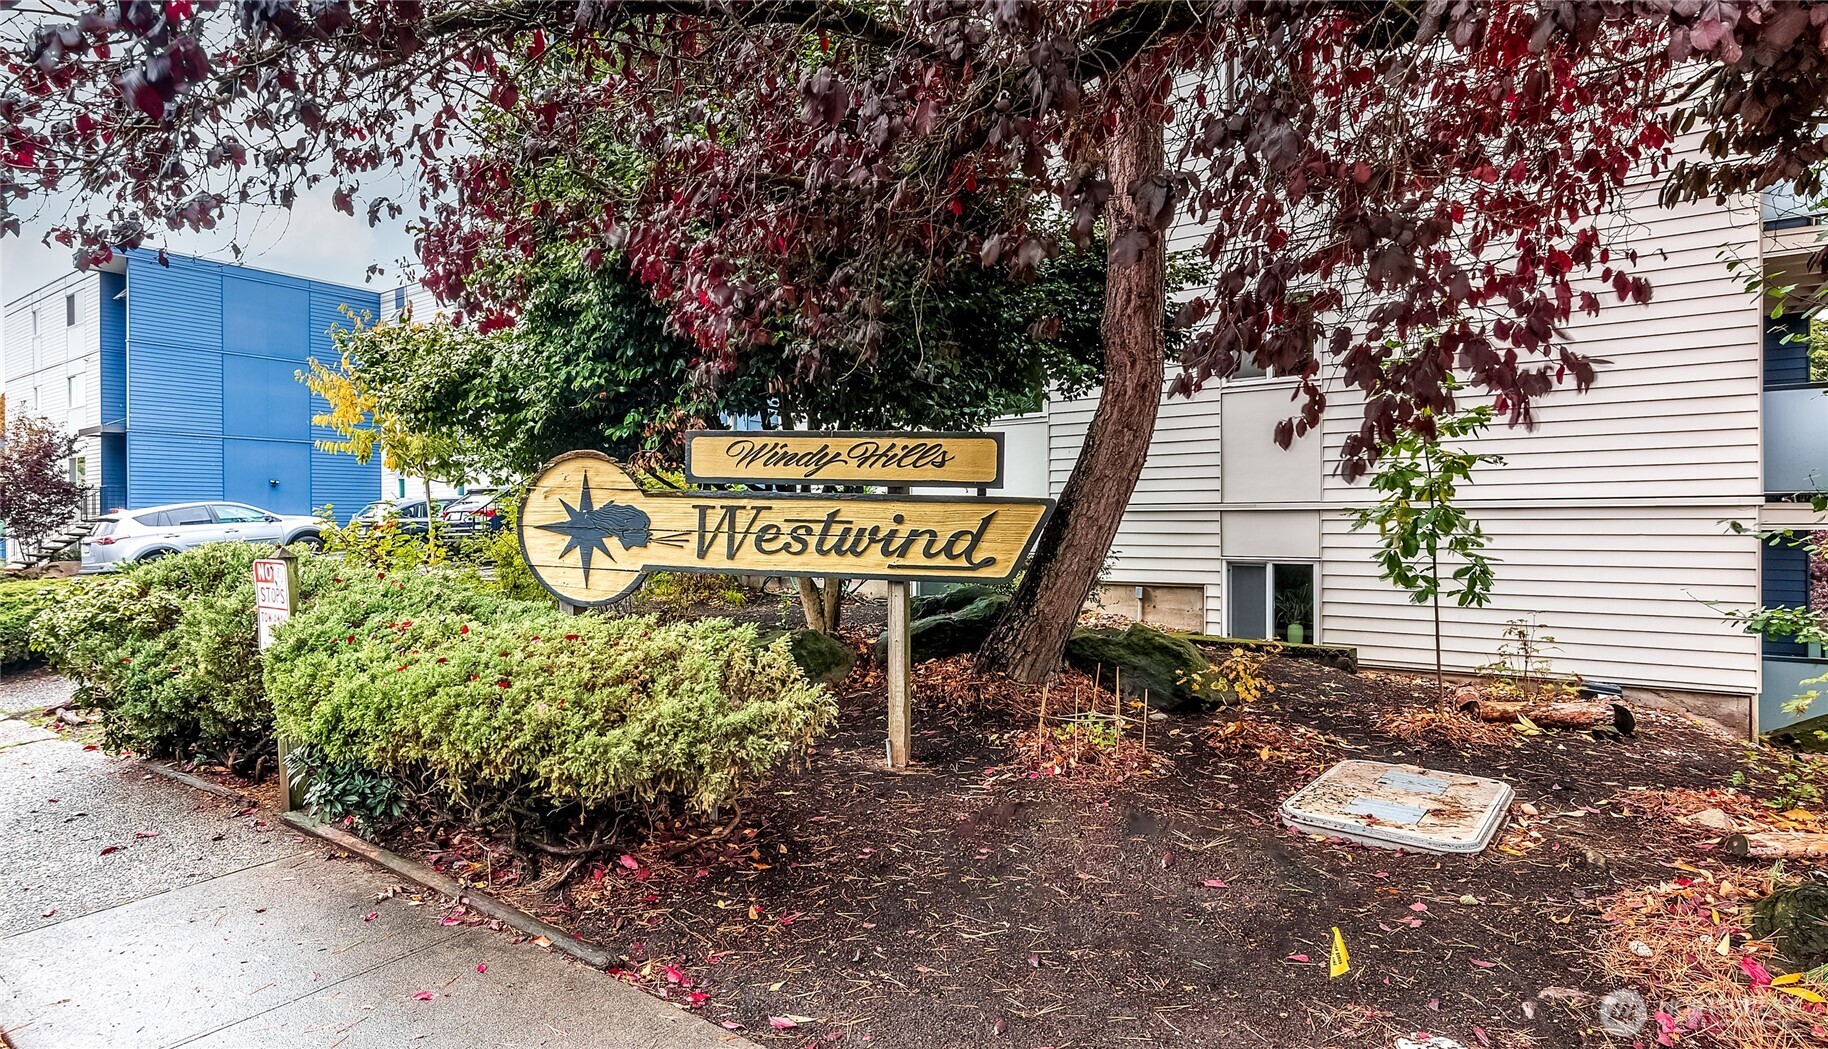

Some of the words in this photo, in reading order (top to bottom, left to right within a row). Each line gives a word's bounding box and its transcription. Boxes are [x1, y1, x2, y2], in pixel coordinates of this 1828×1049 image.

[725, 439, 848, 478] Windy
[846, 441, 955, 469] Hills
[692, 504, 999, 570] Westwind
[258, 563, 272, 581] NO
[260, 587, 285, 604] STOPS
